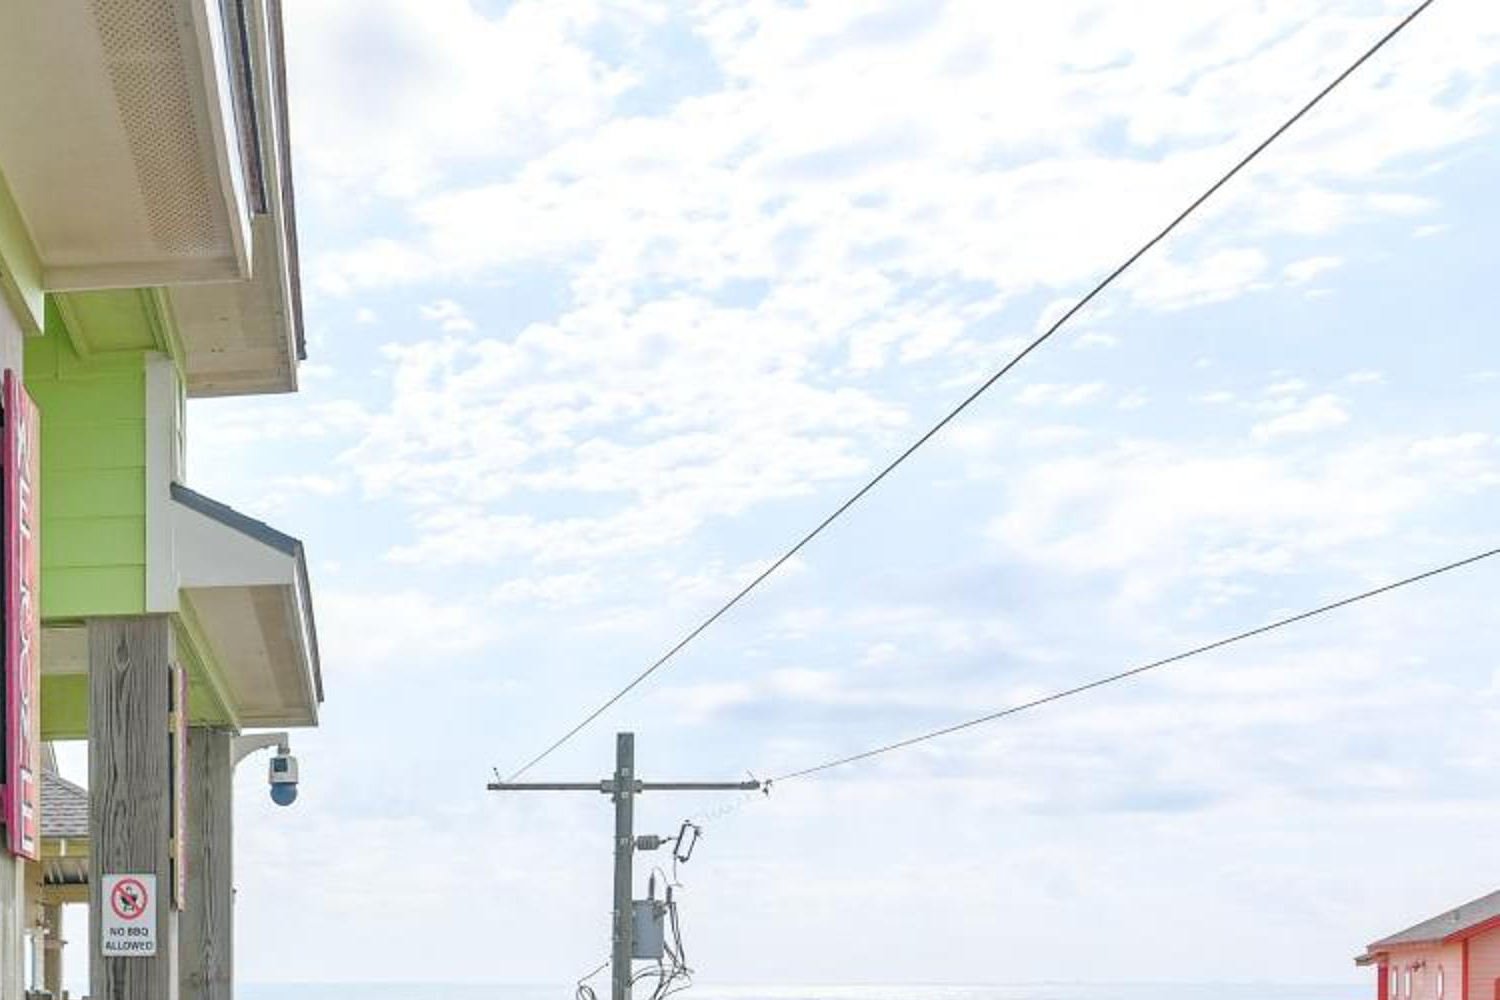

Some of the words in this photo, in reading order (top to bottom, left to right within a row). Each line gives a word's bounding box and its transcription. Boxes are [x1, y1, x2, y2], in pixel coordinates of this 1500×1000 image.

[109, 927, 125, 937] NO
[127, 927, 149, 937] BBQ
[105, 941, 153, 951] ALLOWED
